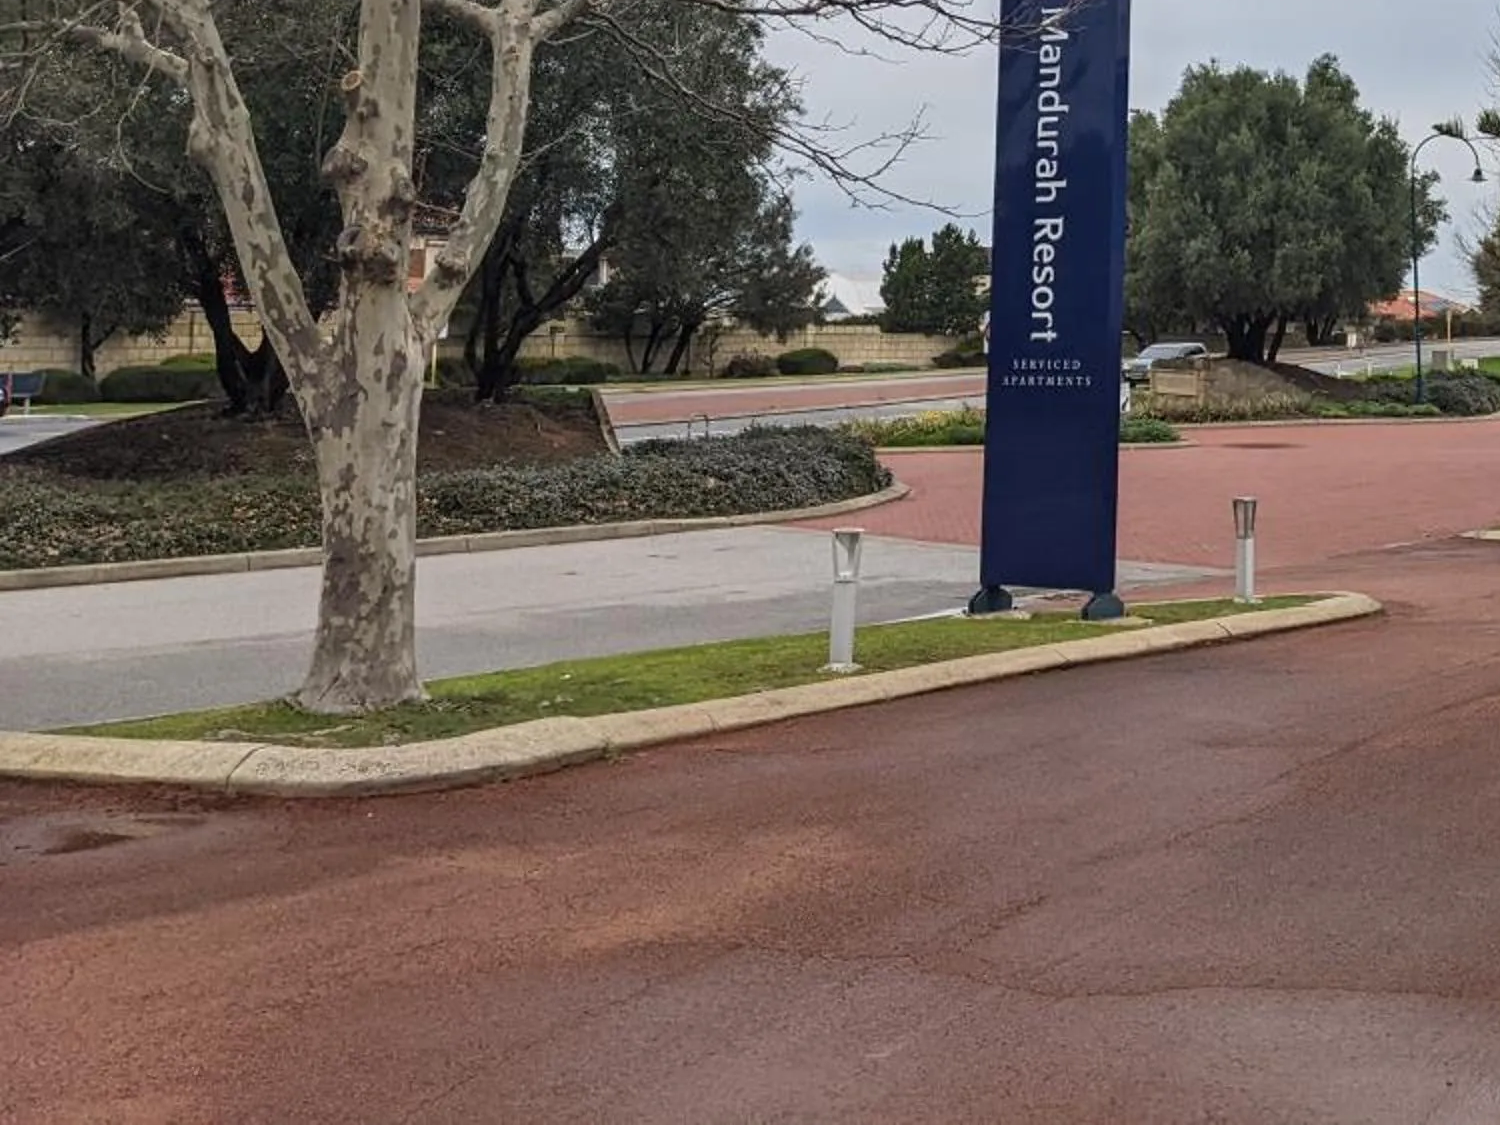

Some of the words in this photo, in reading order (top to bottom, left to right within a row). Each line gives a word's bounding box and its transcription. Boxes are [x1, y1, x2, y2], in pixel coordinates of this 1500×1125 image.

[1034, 7, 1068, 203] Mandurah
[1030, 216, 1064, 342] Resort
[1001, 376, 1092, 386] APARTMENTS
[1012, 359, 1081, 370] SERVICED
